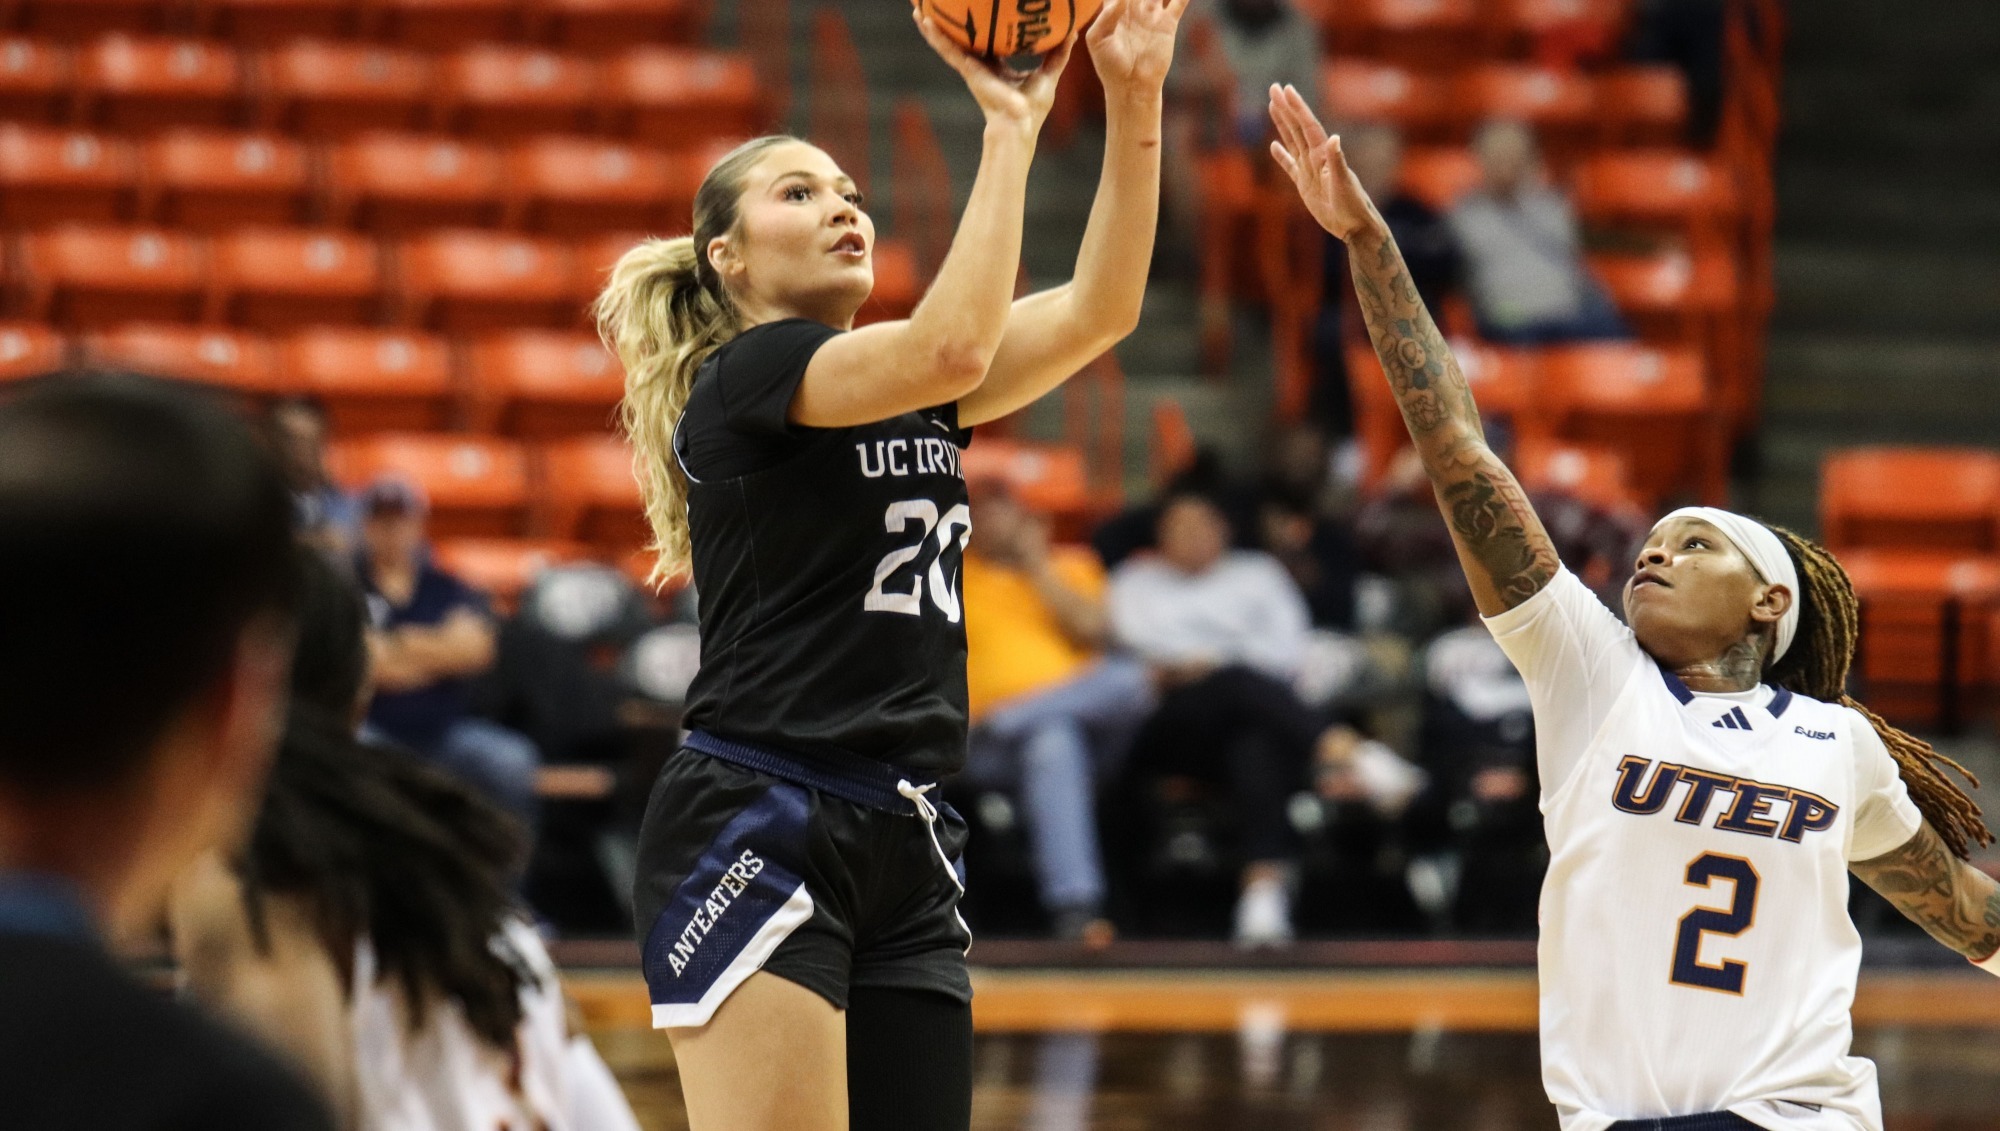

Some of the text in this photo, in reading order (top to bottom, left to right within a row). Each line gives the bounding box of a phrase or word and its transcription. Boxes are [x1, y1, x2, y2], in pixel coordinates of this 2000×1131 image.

[856, 438, 965, 480] UC IRVI
[864, 498, 973, 624] 20
[1612, 754, 1840, 844] UTEP
[667, 848, 765, 978] ANTEATERS
[1668, 849, 1762, 997] 2
